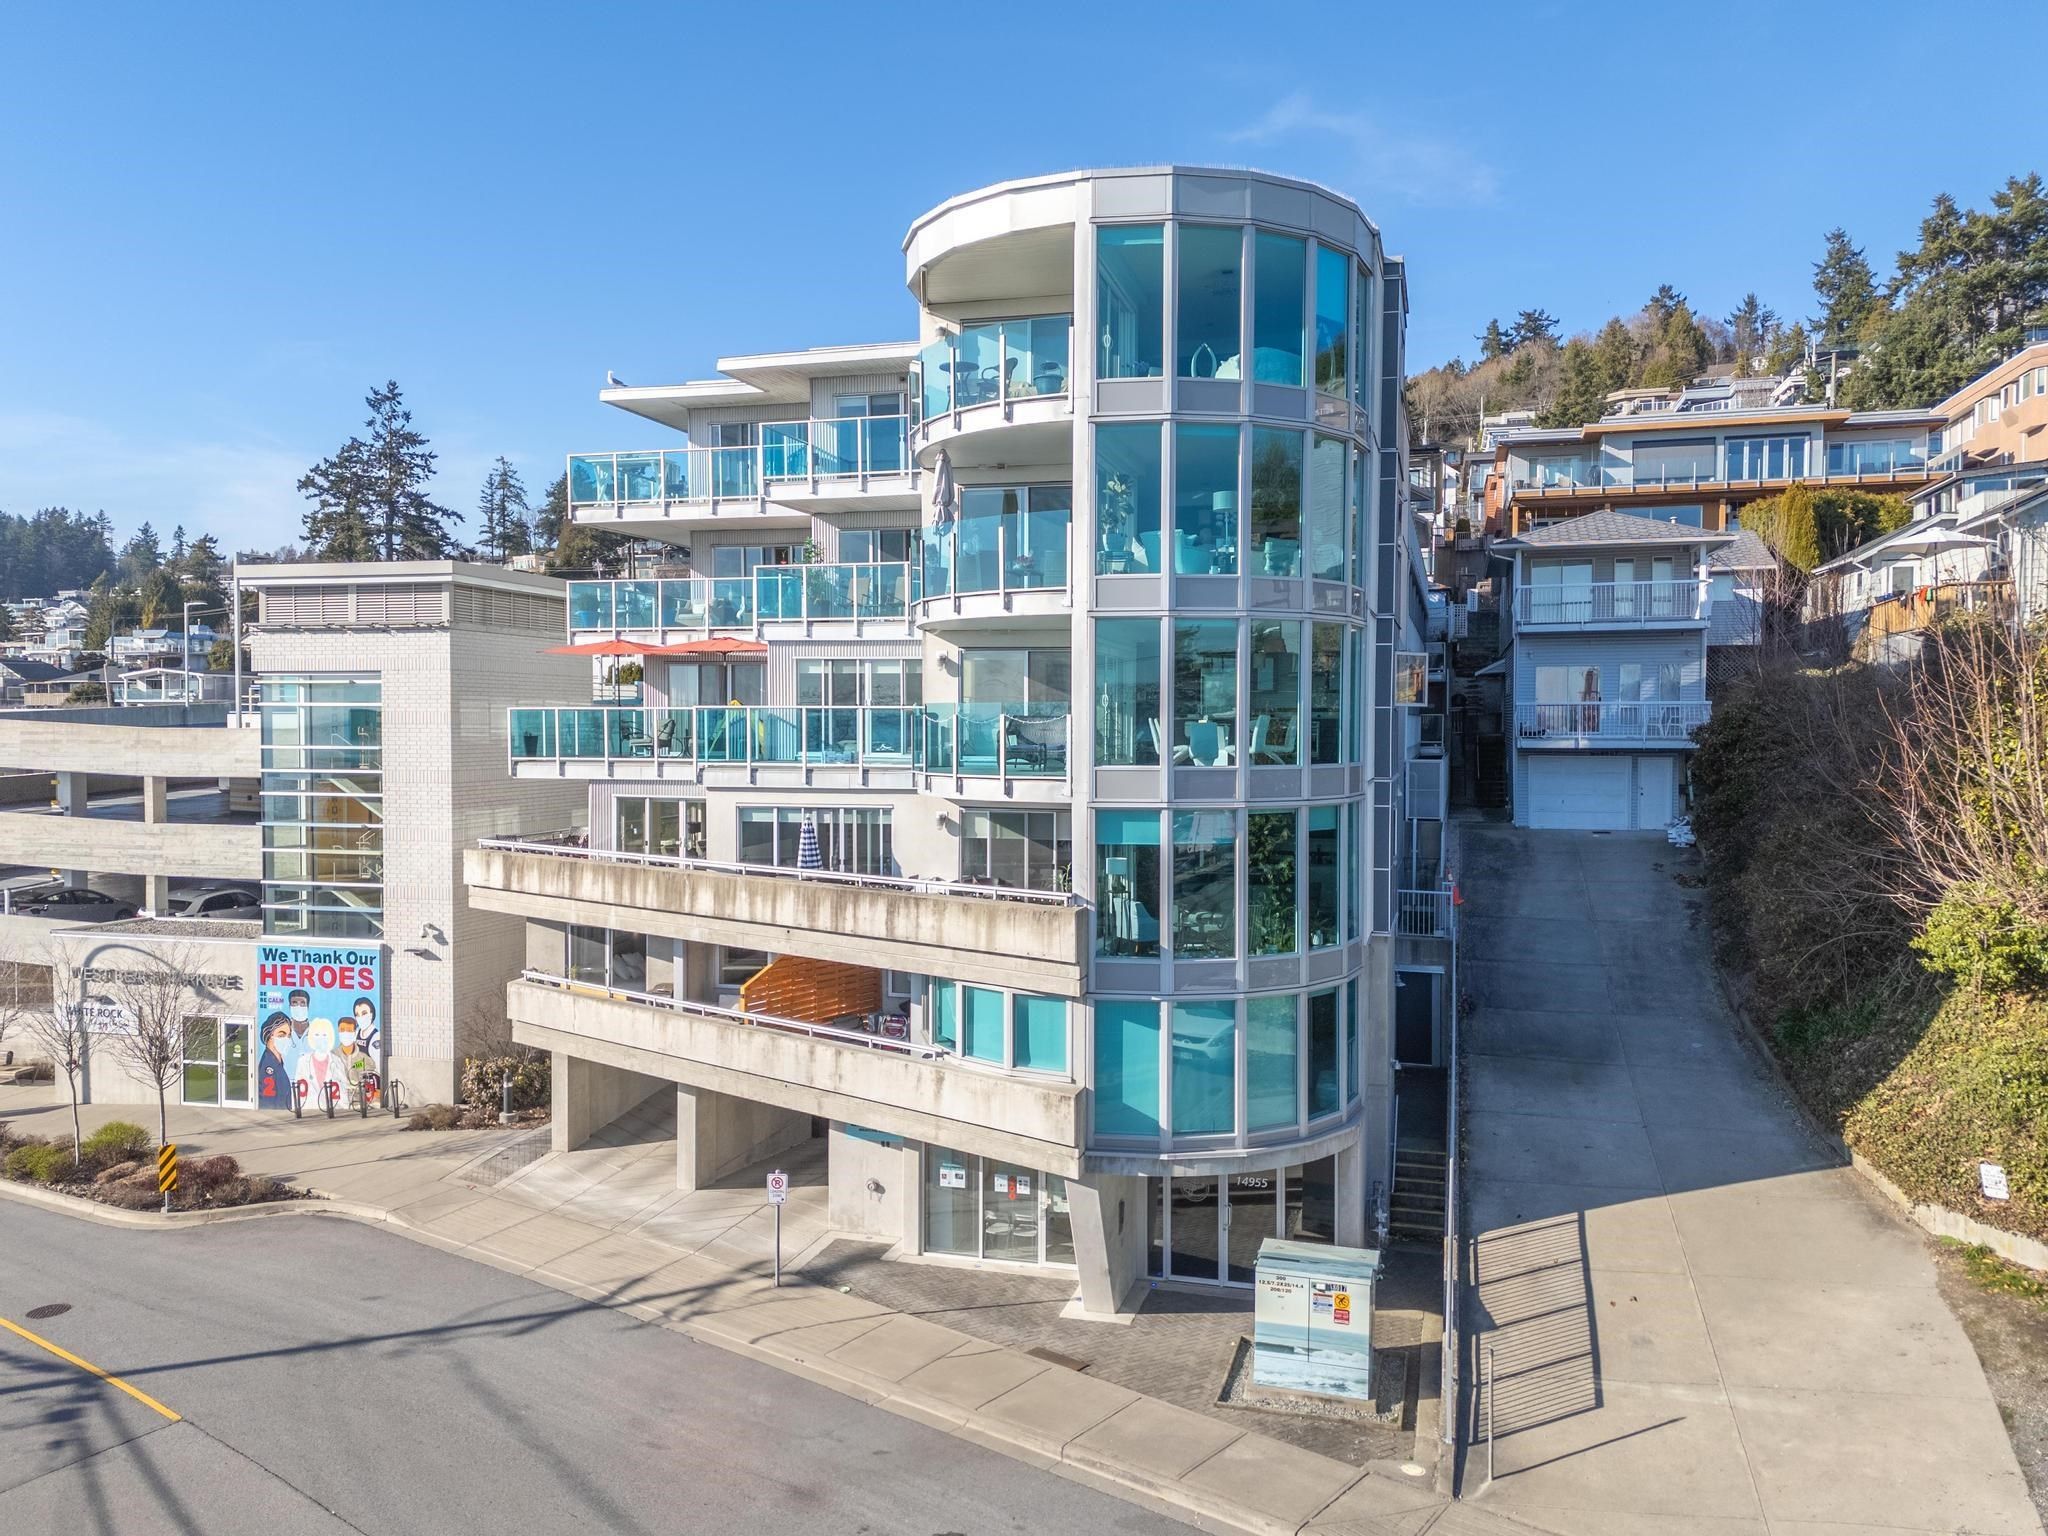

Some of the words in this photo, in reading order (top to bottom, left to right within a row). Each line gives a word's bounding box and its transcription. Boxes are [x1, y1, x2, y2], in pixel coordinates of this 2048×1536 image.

[262, 948, 288, 962] We
[291, 949, 343, 964] Thank
[346, 951, 377, 966] Our
[259, 963, 375, 991] HEROES
[97, 1007, 123, 1019] ROCK
[262, 1077, 277, 1097] 2
[1236, 1176, 1269, 1189] 14955
